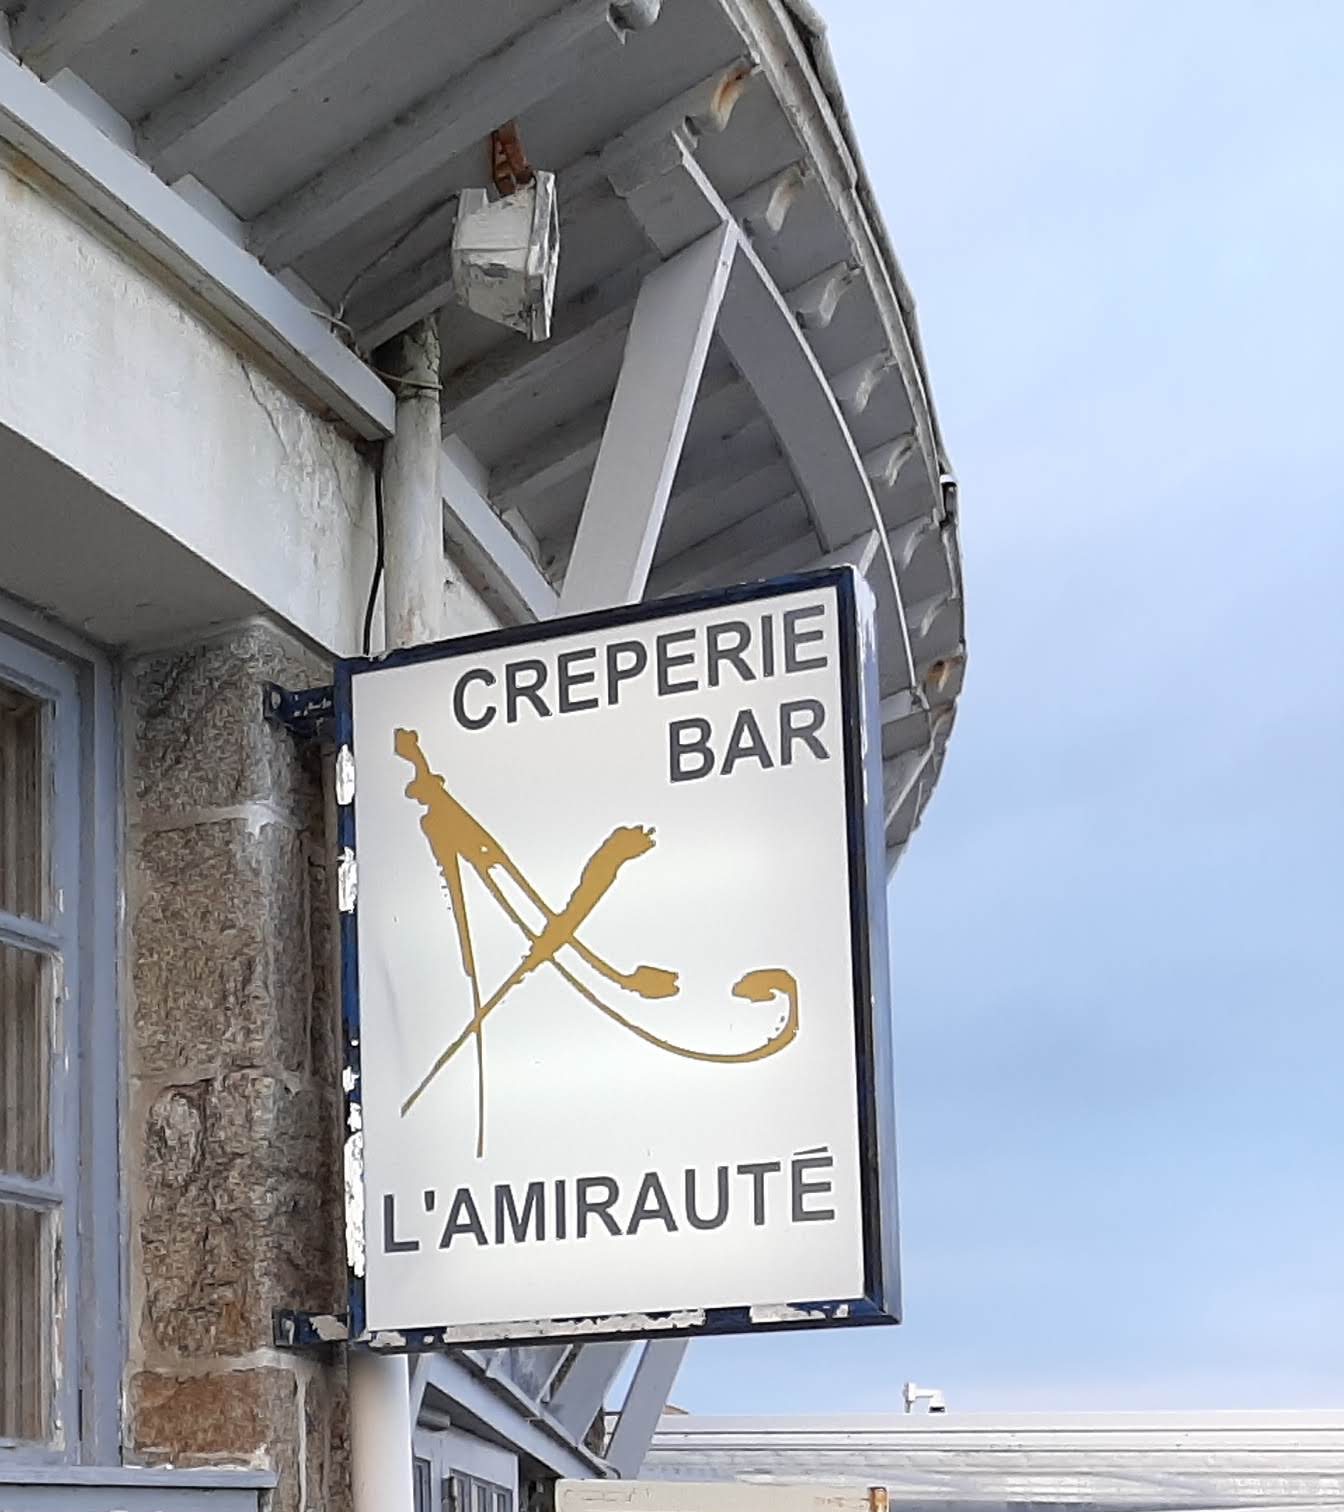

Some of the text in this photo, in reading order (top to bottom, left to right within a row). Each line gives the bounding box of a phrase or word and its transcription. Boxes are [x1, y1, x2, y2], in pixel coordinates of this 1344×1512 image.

[452, 604, 829, 731] CREPERIE
[669, 698, 830, 784] BAR
[383, 1145, 836, 1254] L'AMIRAUTÉ
